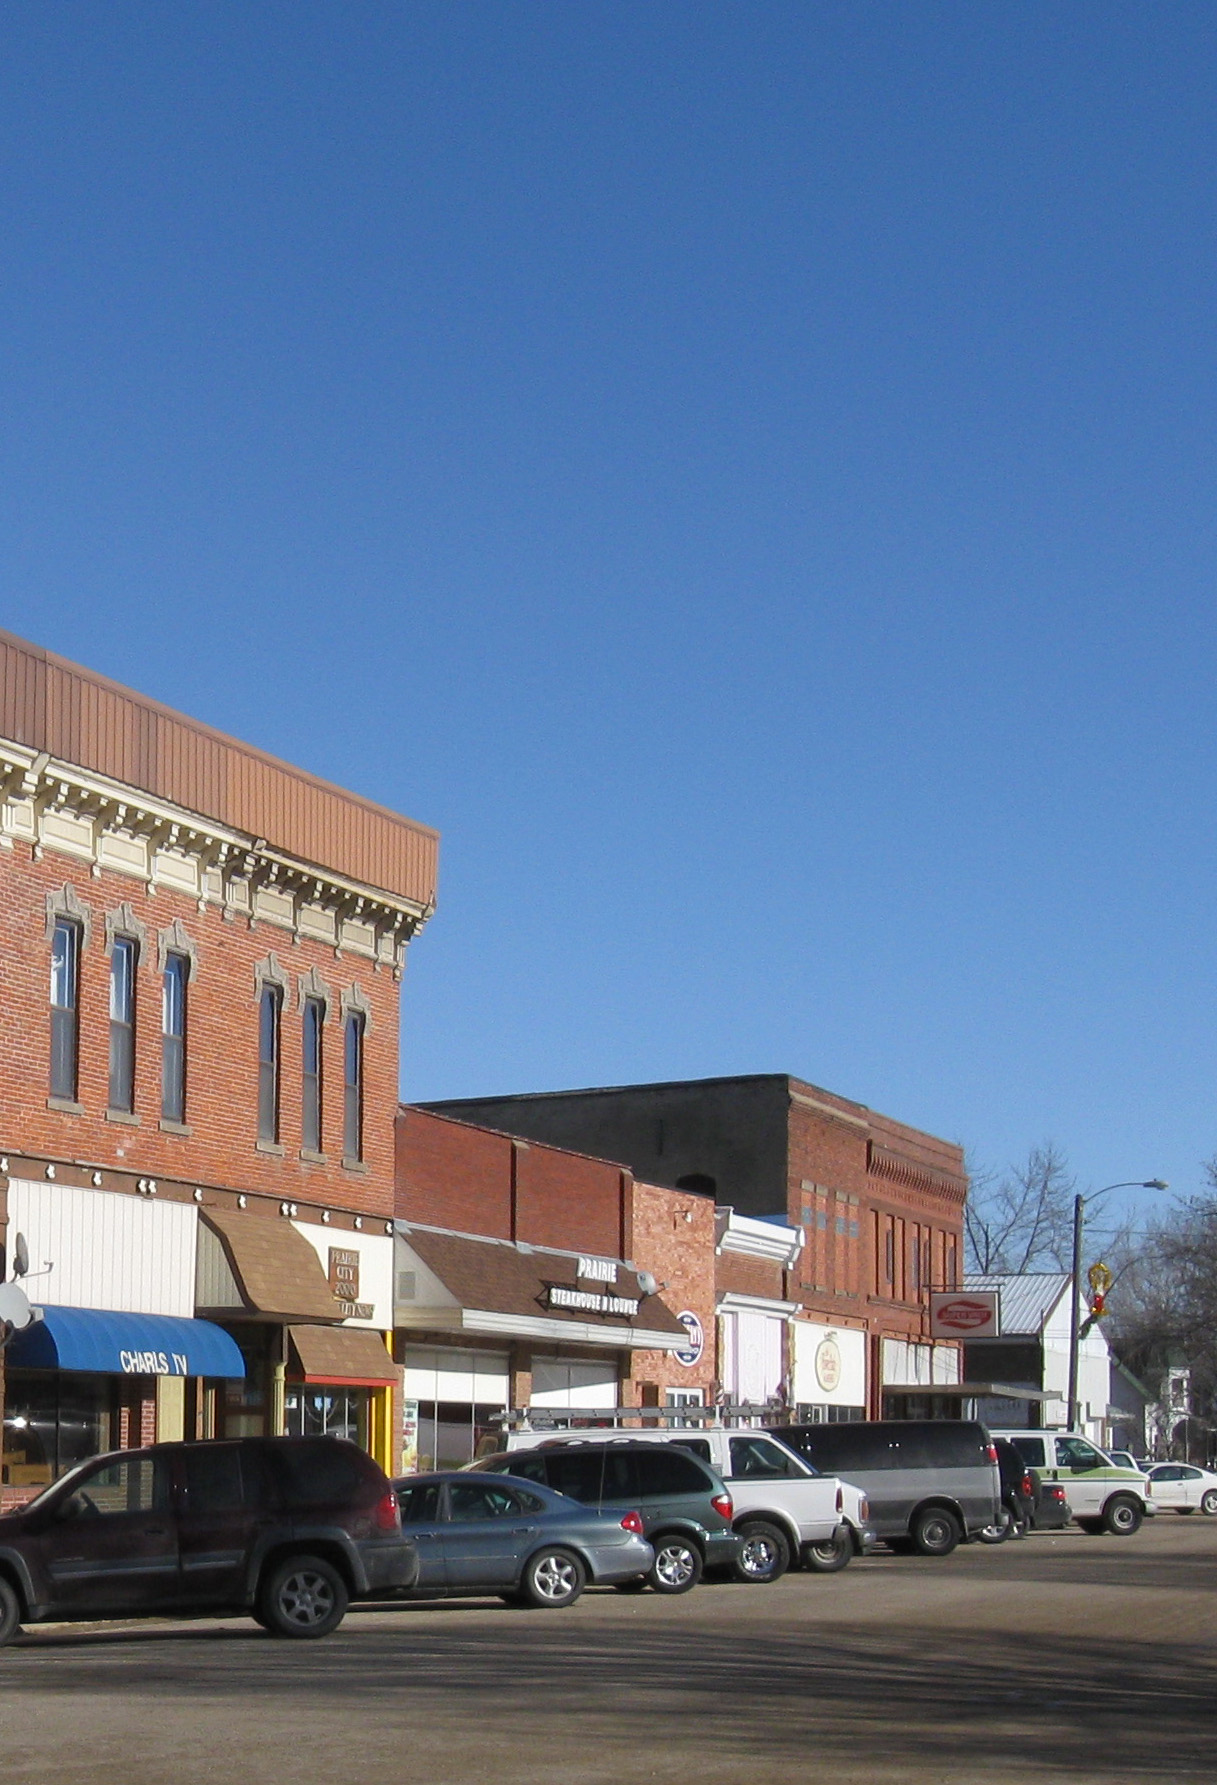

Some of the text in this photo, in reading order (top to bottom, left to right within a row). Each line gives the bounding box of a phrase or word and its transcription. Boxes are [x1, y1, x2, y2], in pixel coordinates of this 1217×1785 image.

[336, 1265, 355, 1281] CITY
[577, 1257, 617, 1283] PRAIRIE
[335, 1281, 357, 1296] 2000
[550, 1287, 601, 1311] STEAKHOUSE
[608, 1296, 639, 1316] LOUNGE
[120, 1350, 187, 1375] CHARLS TV
